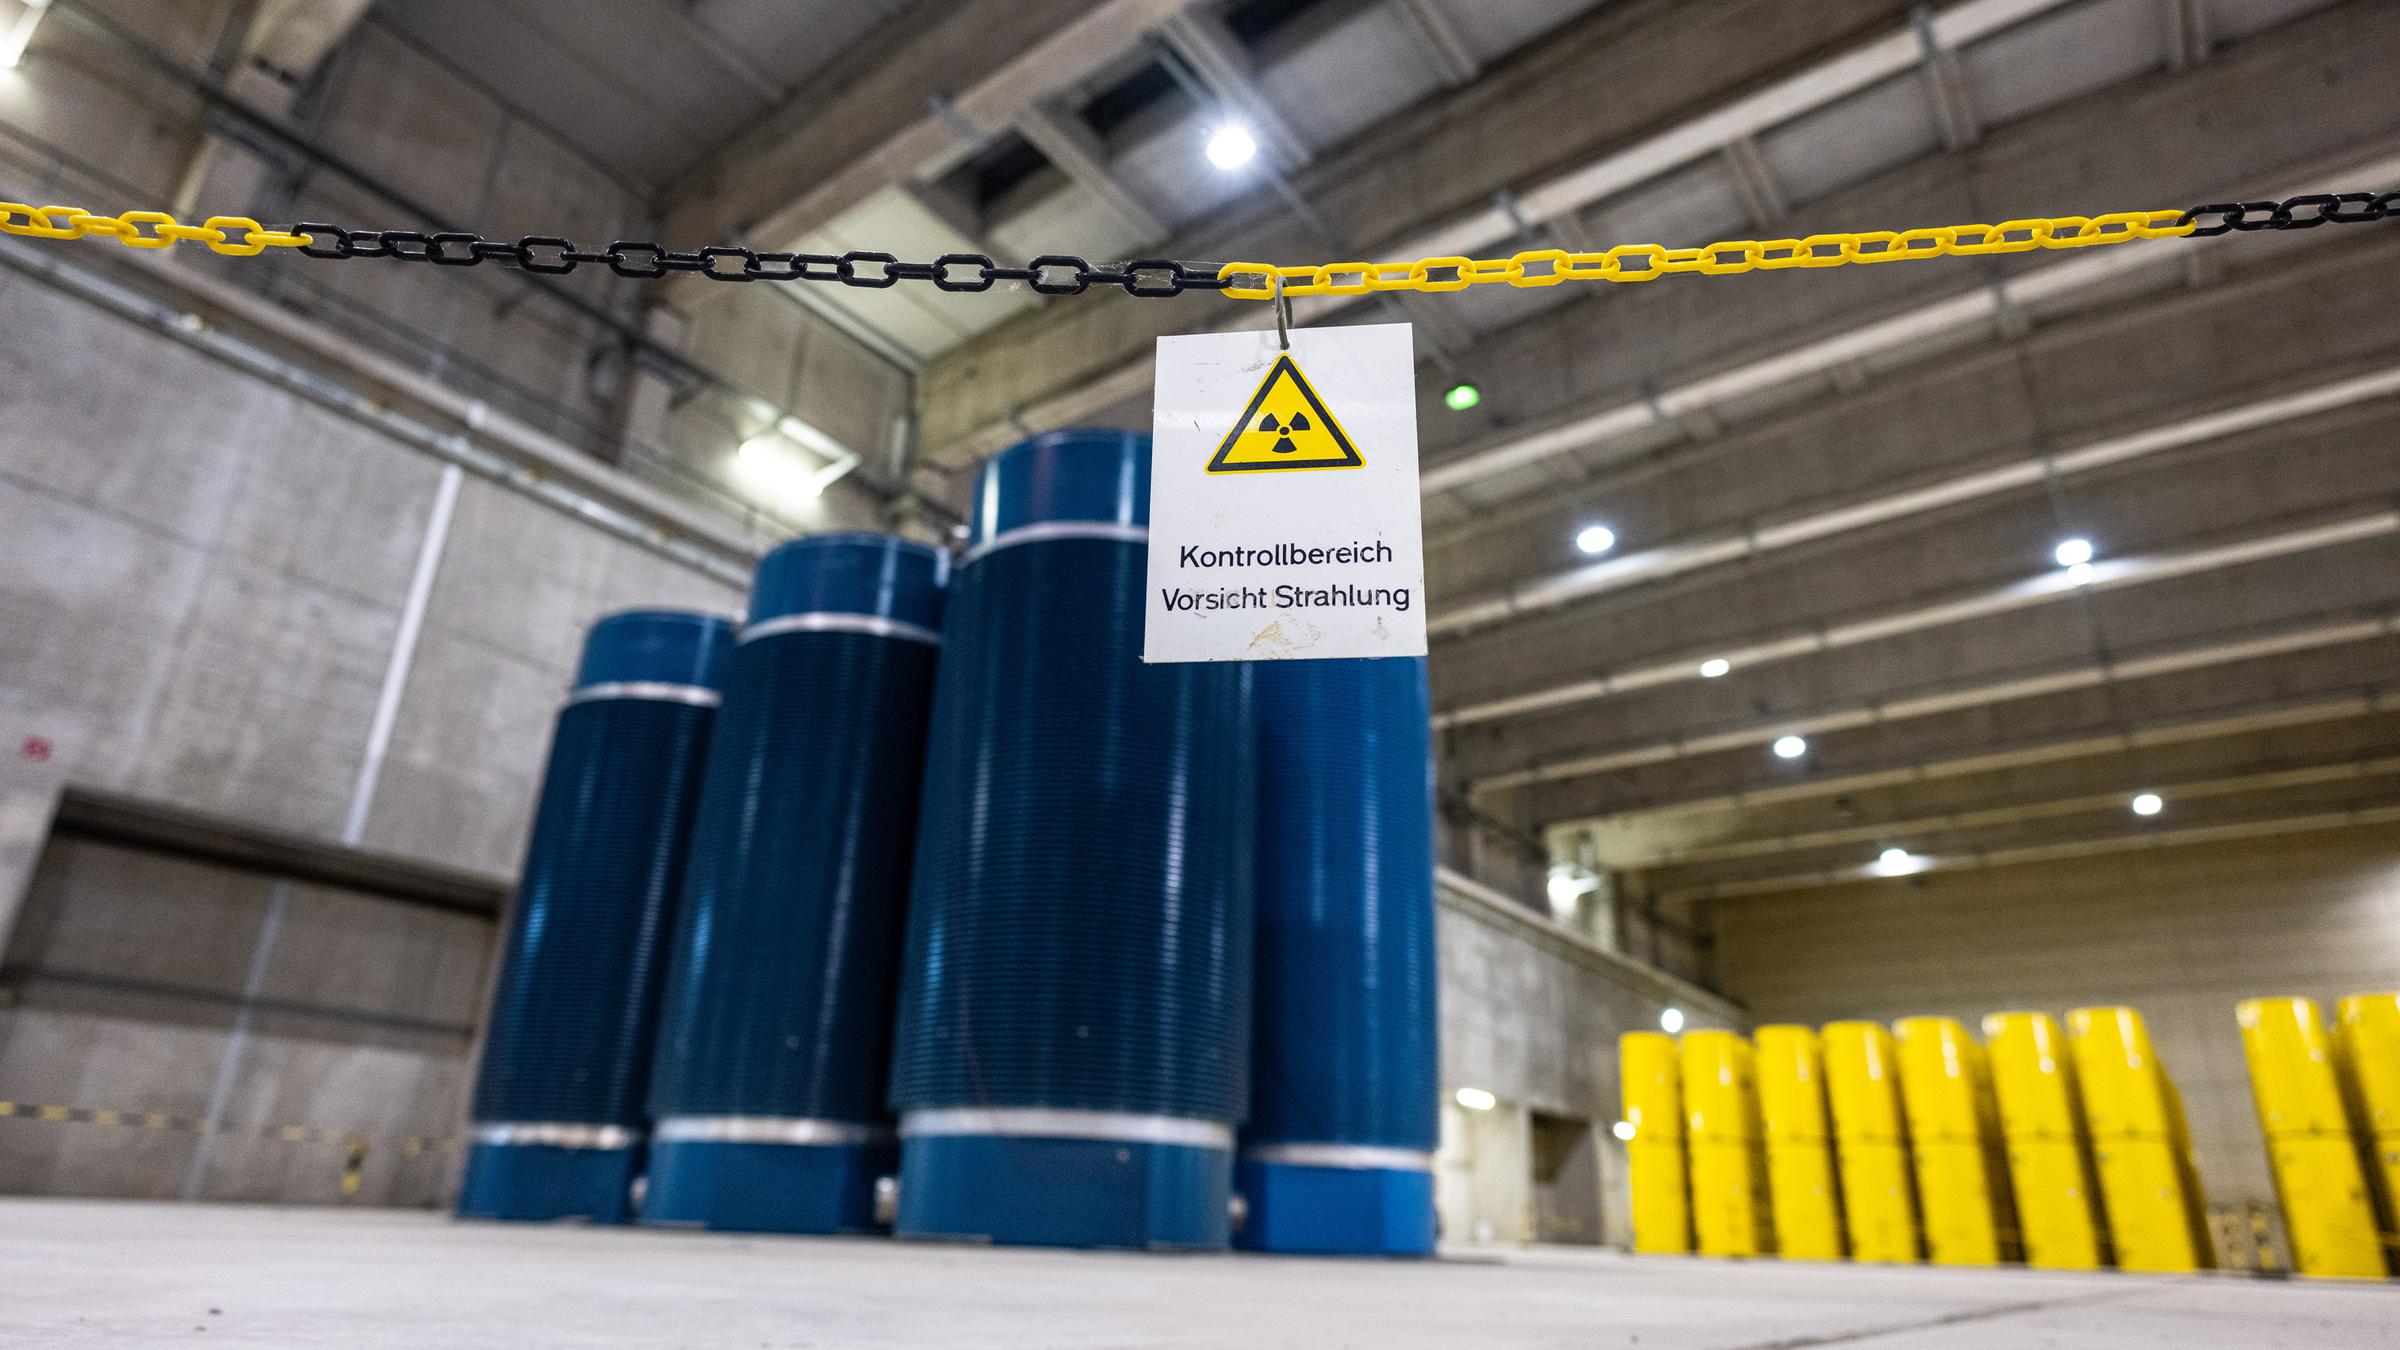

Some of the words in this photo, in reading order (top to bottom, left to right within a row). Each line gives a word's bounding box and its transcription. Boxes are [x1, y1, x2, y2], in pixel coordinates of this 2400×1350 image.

[1180, 541, 1392, 568] Kontrollbereich
[1162, 587, 1267, 611] Vorsicht
[1275, 584, 1409, 611] Strahlung
